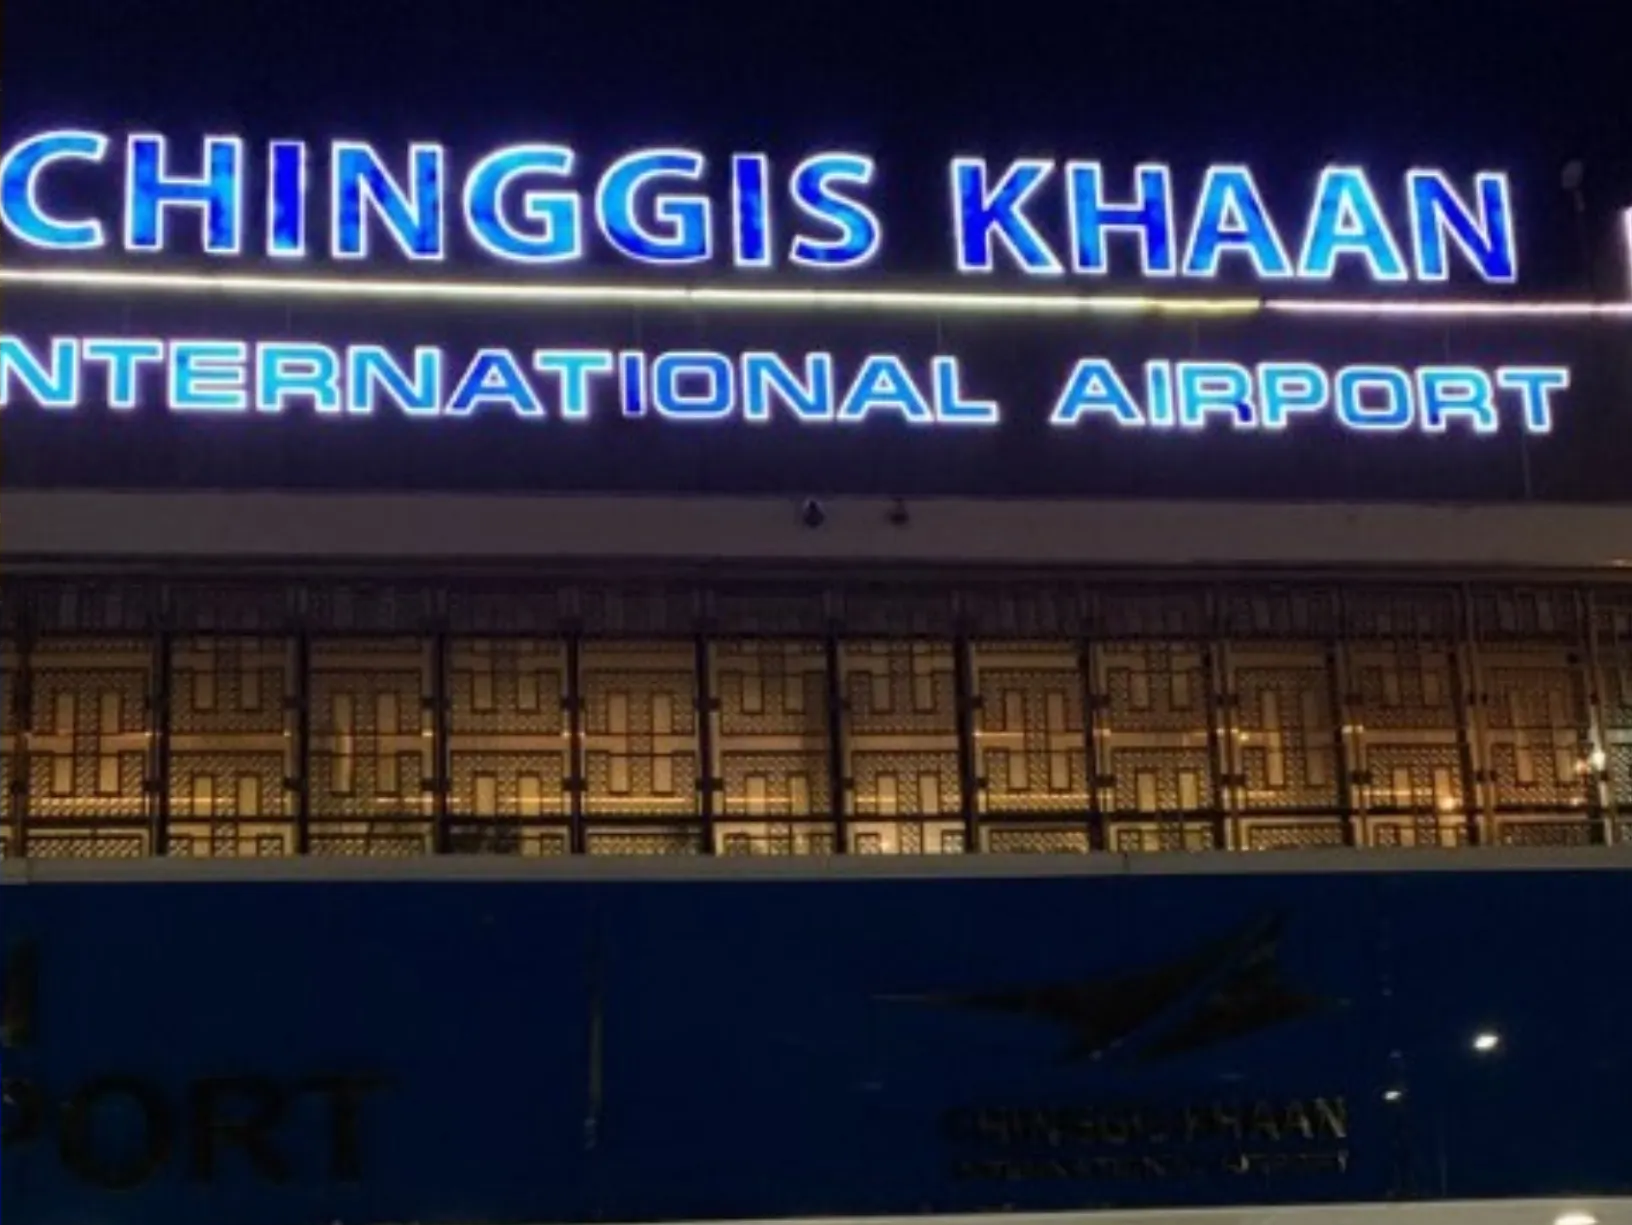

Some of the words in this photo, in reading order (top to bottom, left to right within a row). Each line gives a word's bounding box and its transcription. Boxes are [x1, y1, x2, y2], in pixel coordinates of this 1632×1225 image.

[0, 129, 881, 268] CHINGGIS
[951, 156, 1518, 283] KHAAN
[0, 336, 1000, 425] NTERNATIONAL
[1049, 358, 1571, 433] AIRPORT
